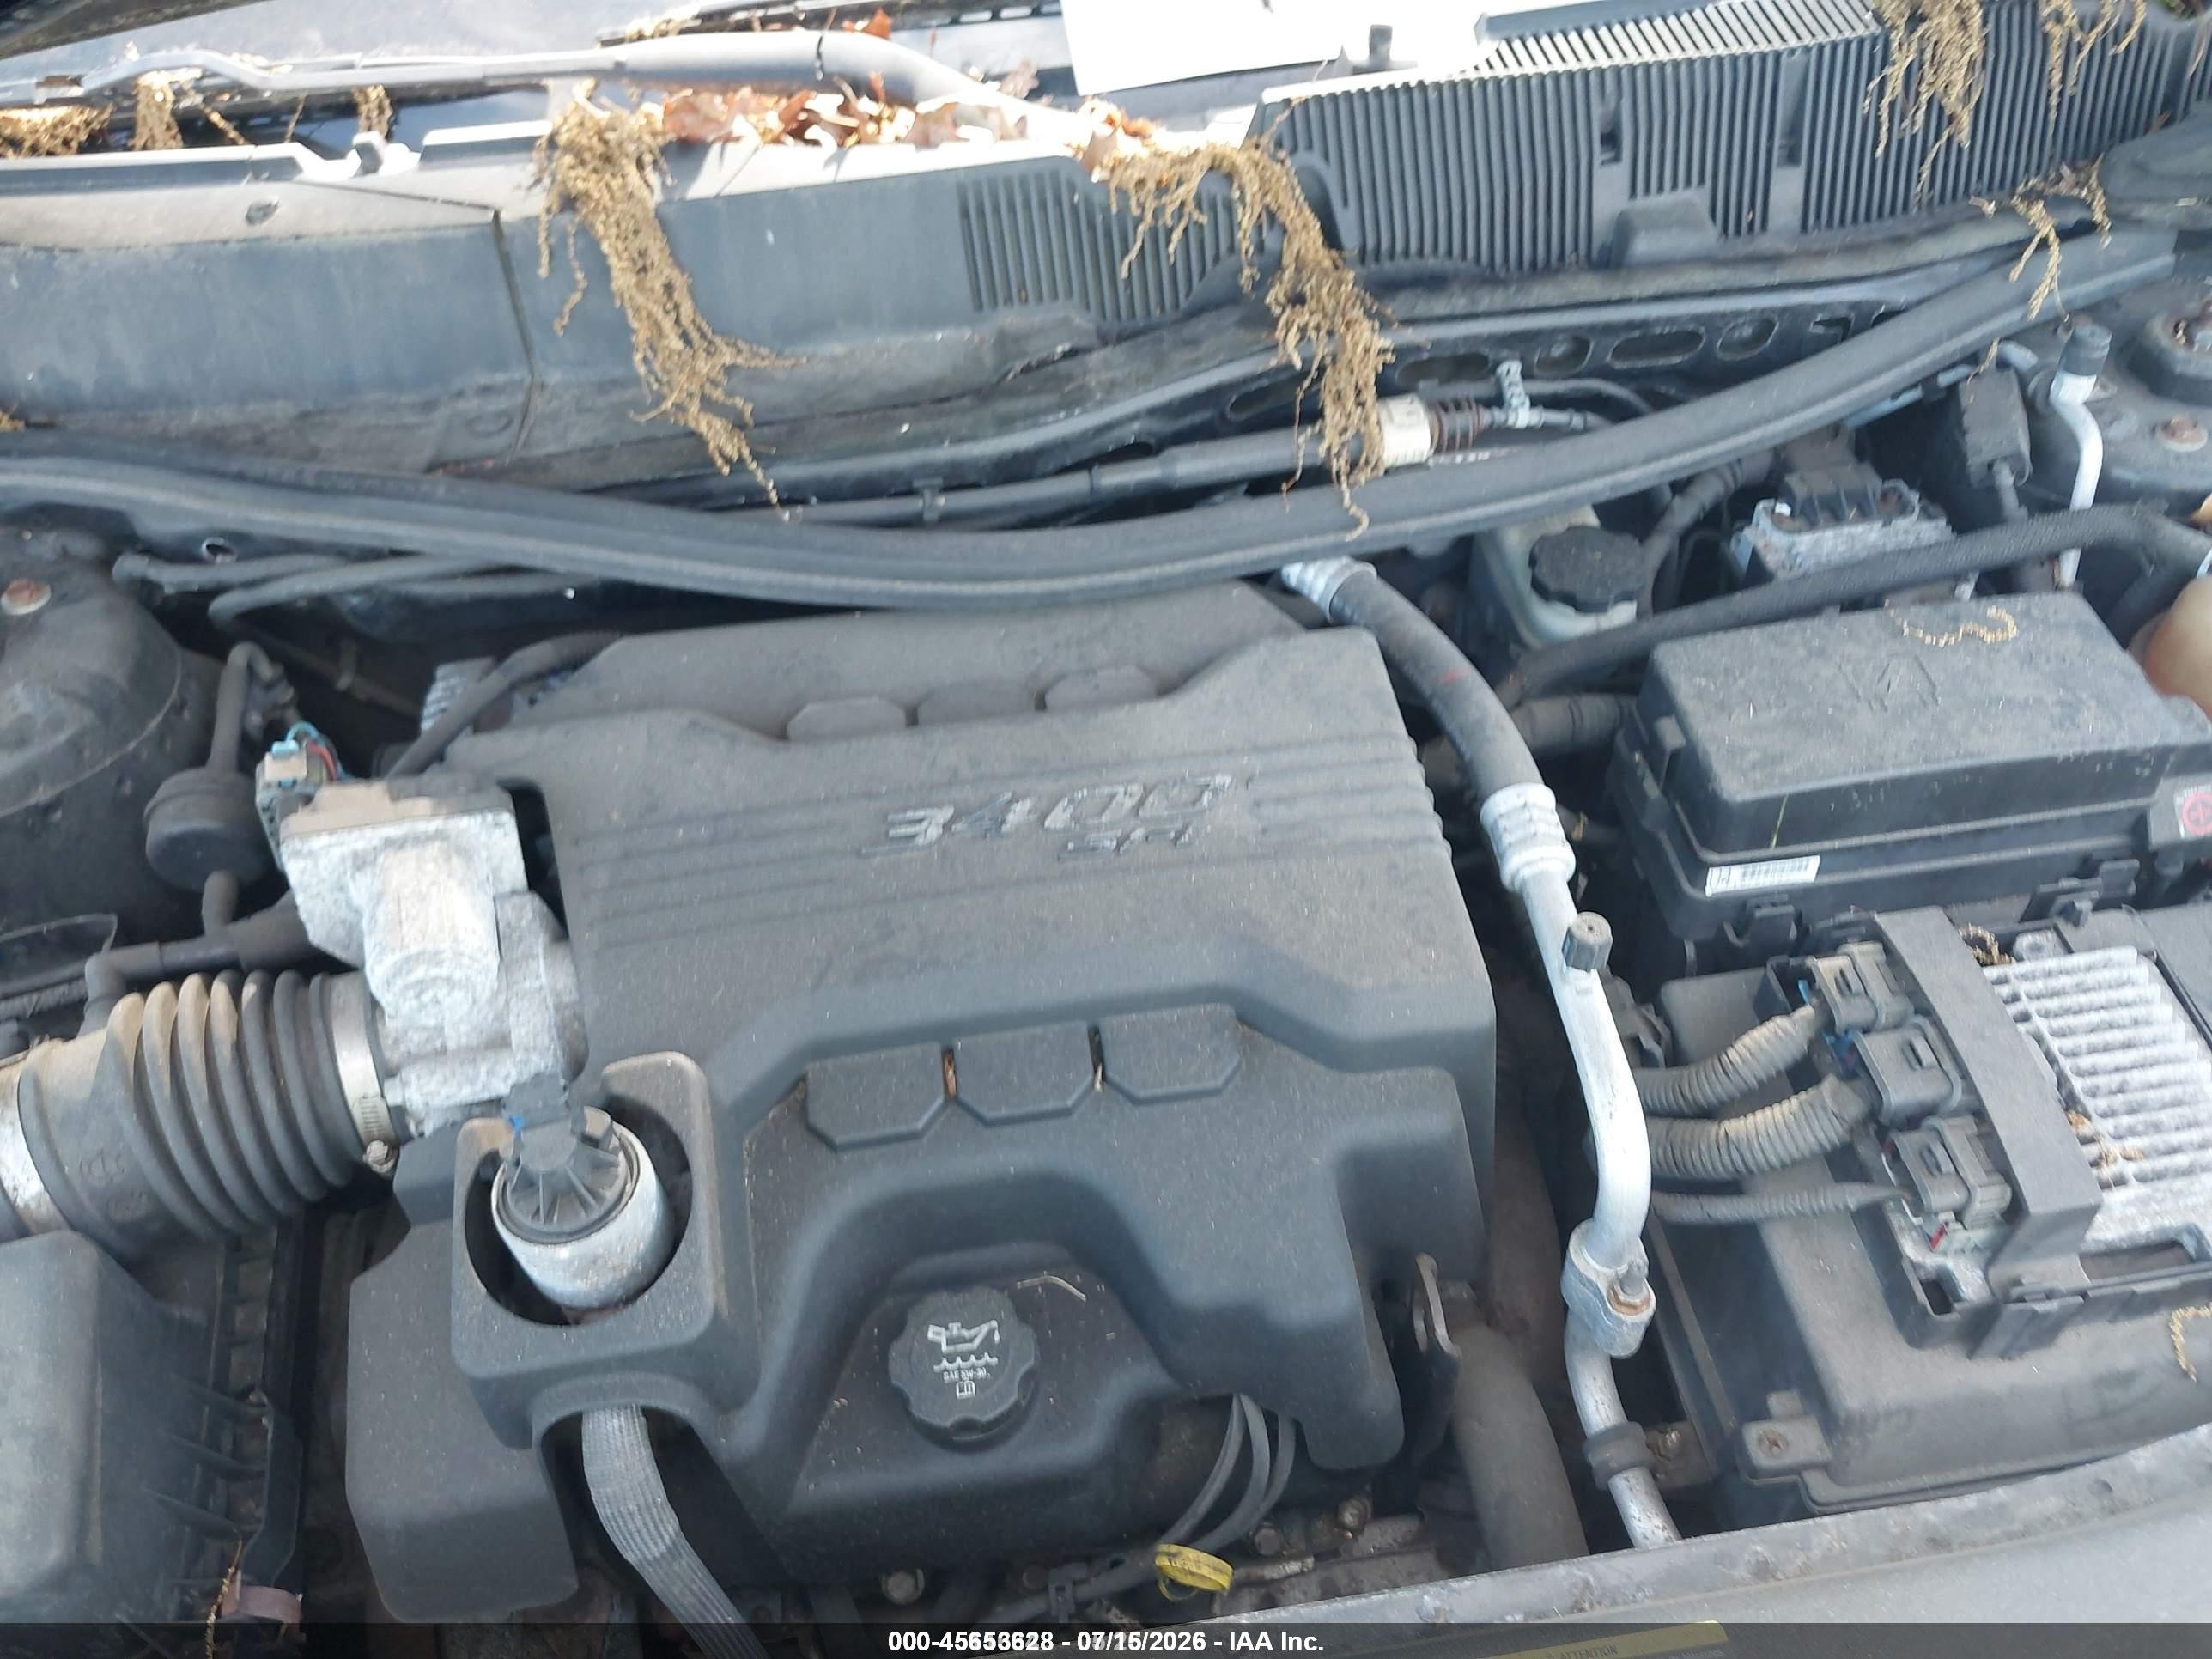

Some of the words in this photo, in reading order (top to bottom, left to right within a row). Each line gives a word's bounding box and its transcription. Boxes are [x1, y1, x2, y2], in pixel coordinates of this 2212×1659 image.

[861, 773, 1232, 854] 3400
[943, 1370, 959, 1381] SAE
[1560, 1644, 1618, 1659] ATTENTION
